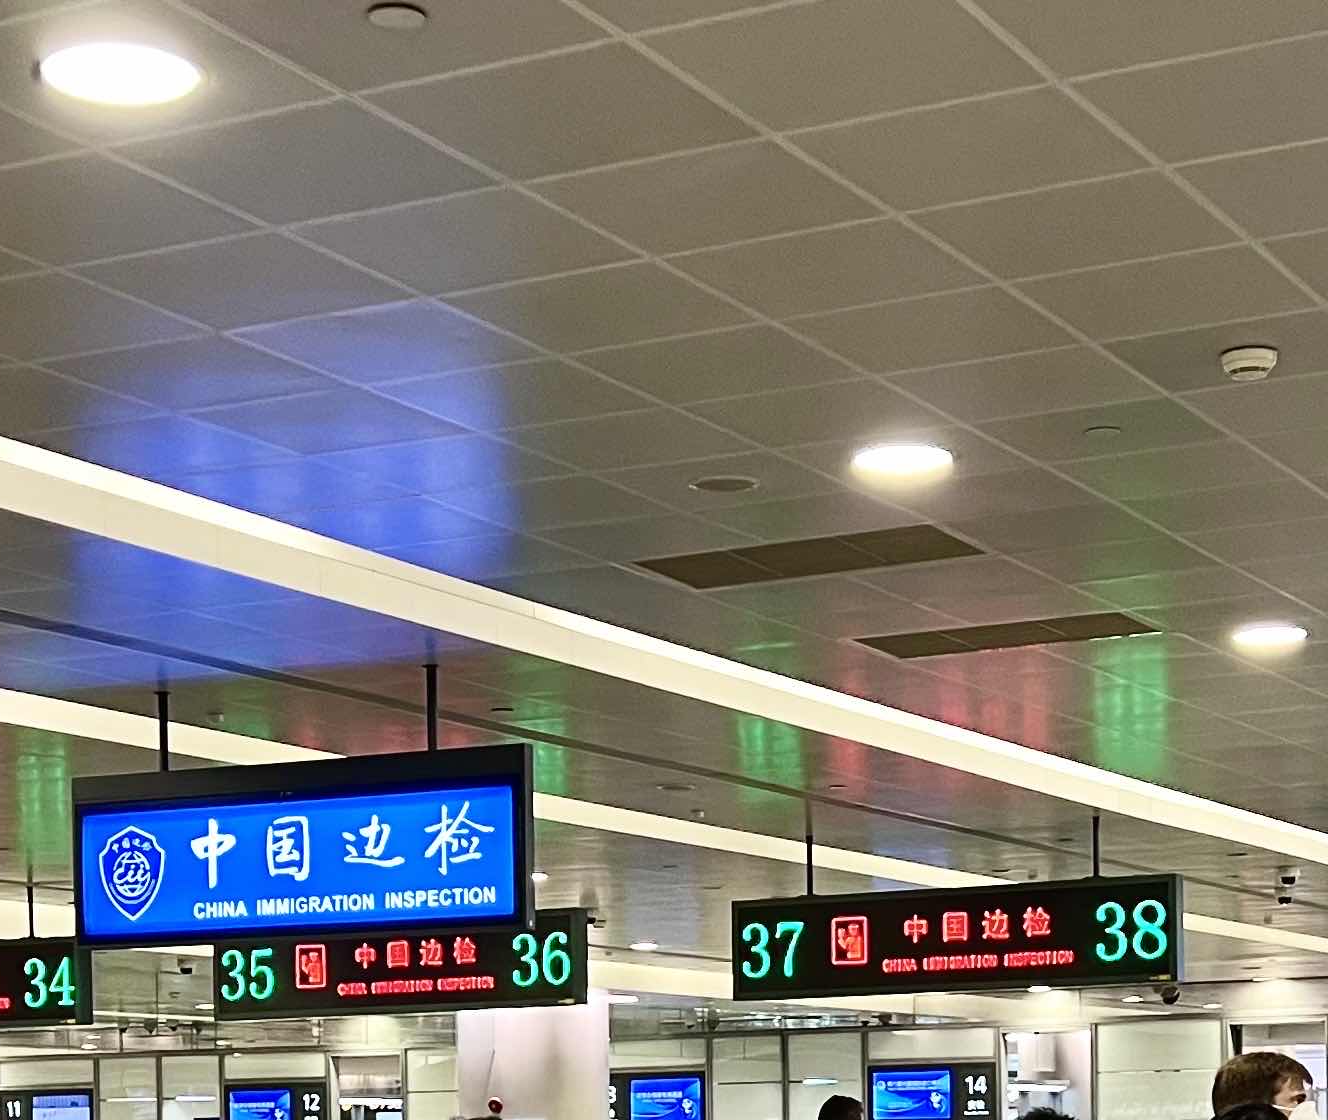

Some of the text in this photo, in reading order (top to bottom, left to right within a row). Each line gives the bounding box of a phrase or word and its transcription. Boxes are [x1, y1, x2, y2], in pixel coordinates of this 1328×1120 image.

[191, 802, 495, 892] 中国边检
[194, 887, 495, 918] CHINA IMMIGRATION INSPECTION
[904, 907, 1050, 943] 中国边检
[1096, 900, 1167, 961] 38
[355, 937, 476, 969] 中国边检
[513, 932, 570, 987] 36
[743, 922, 804, 978] 37
[25, 957, 75, 1007] 34
[221, 948, 274, 1001] 35
[303, 1094, 320, 1111] 12
[965, 1076, 987, 1094] 14
[7, 1101, 20, 1117] 11
